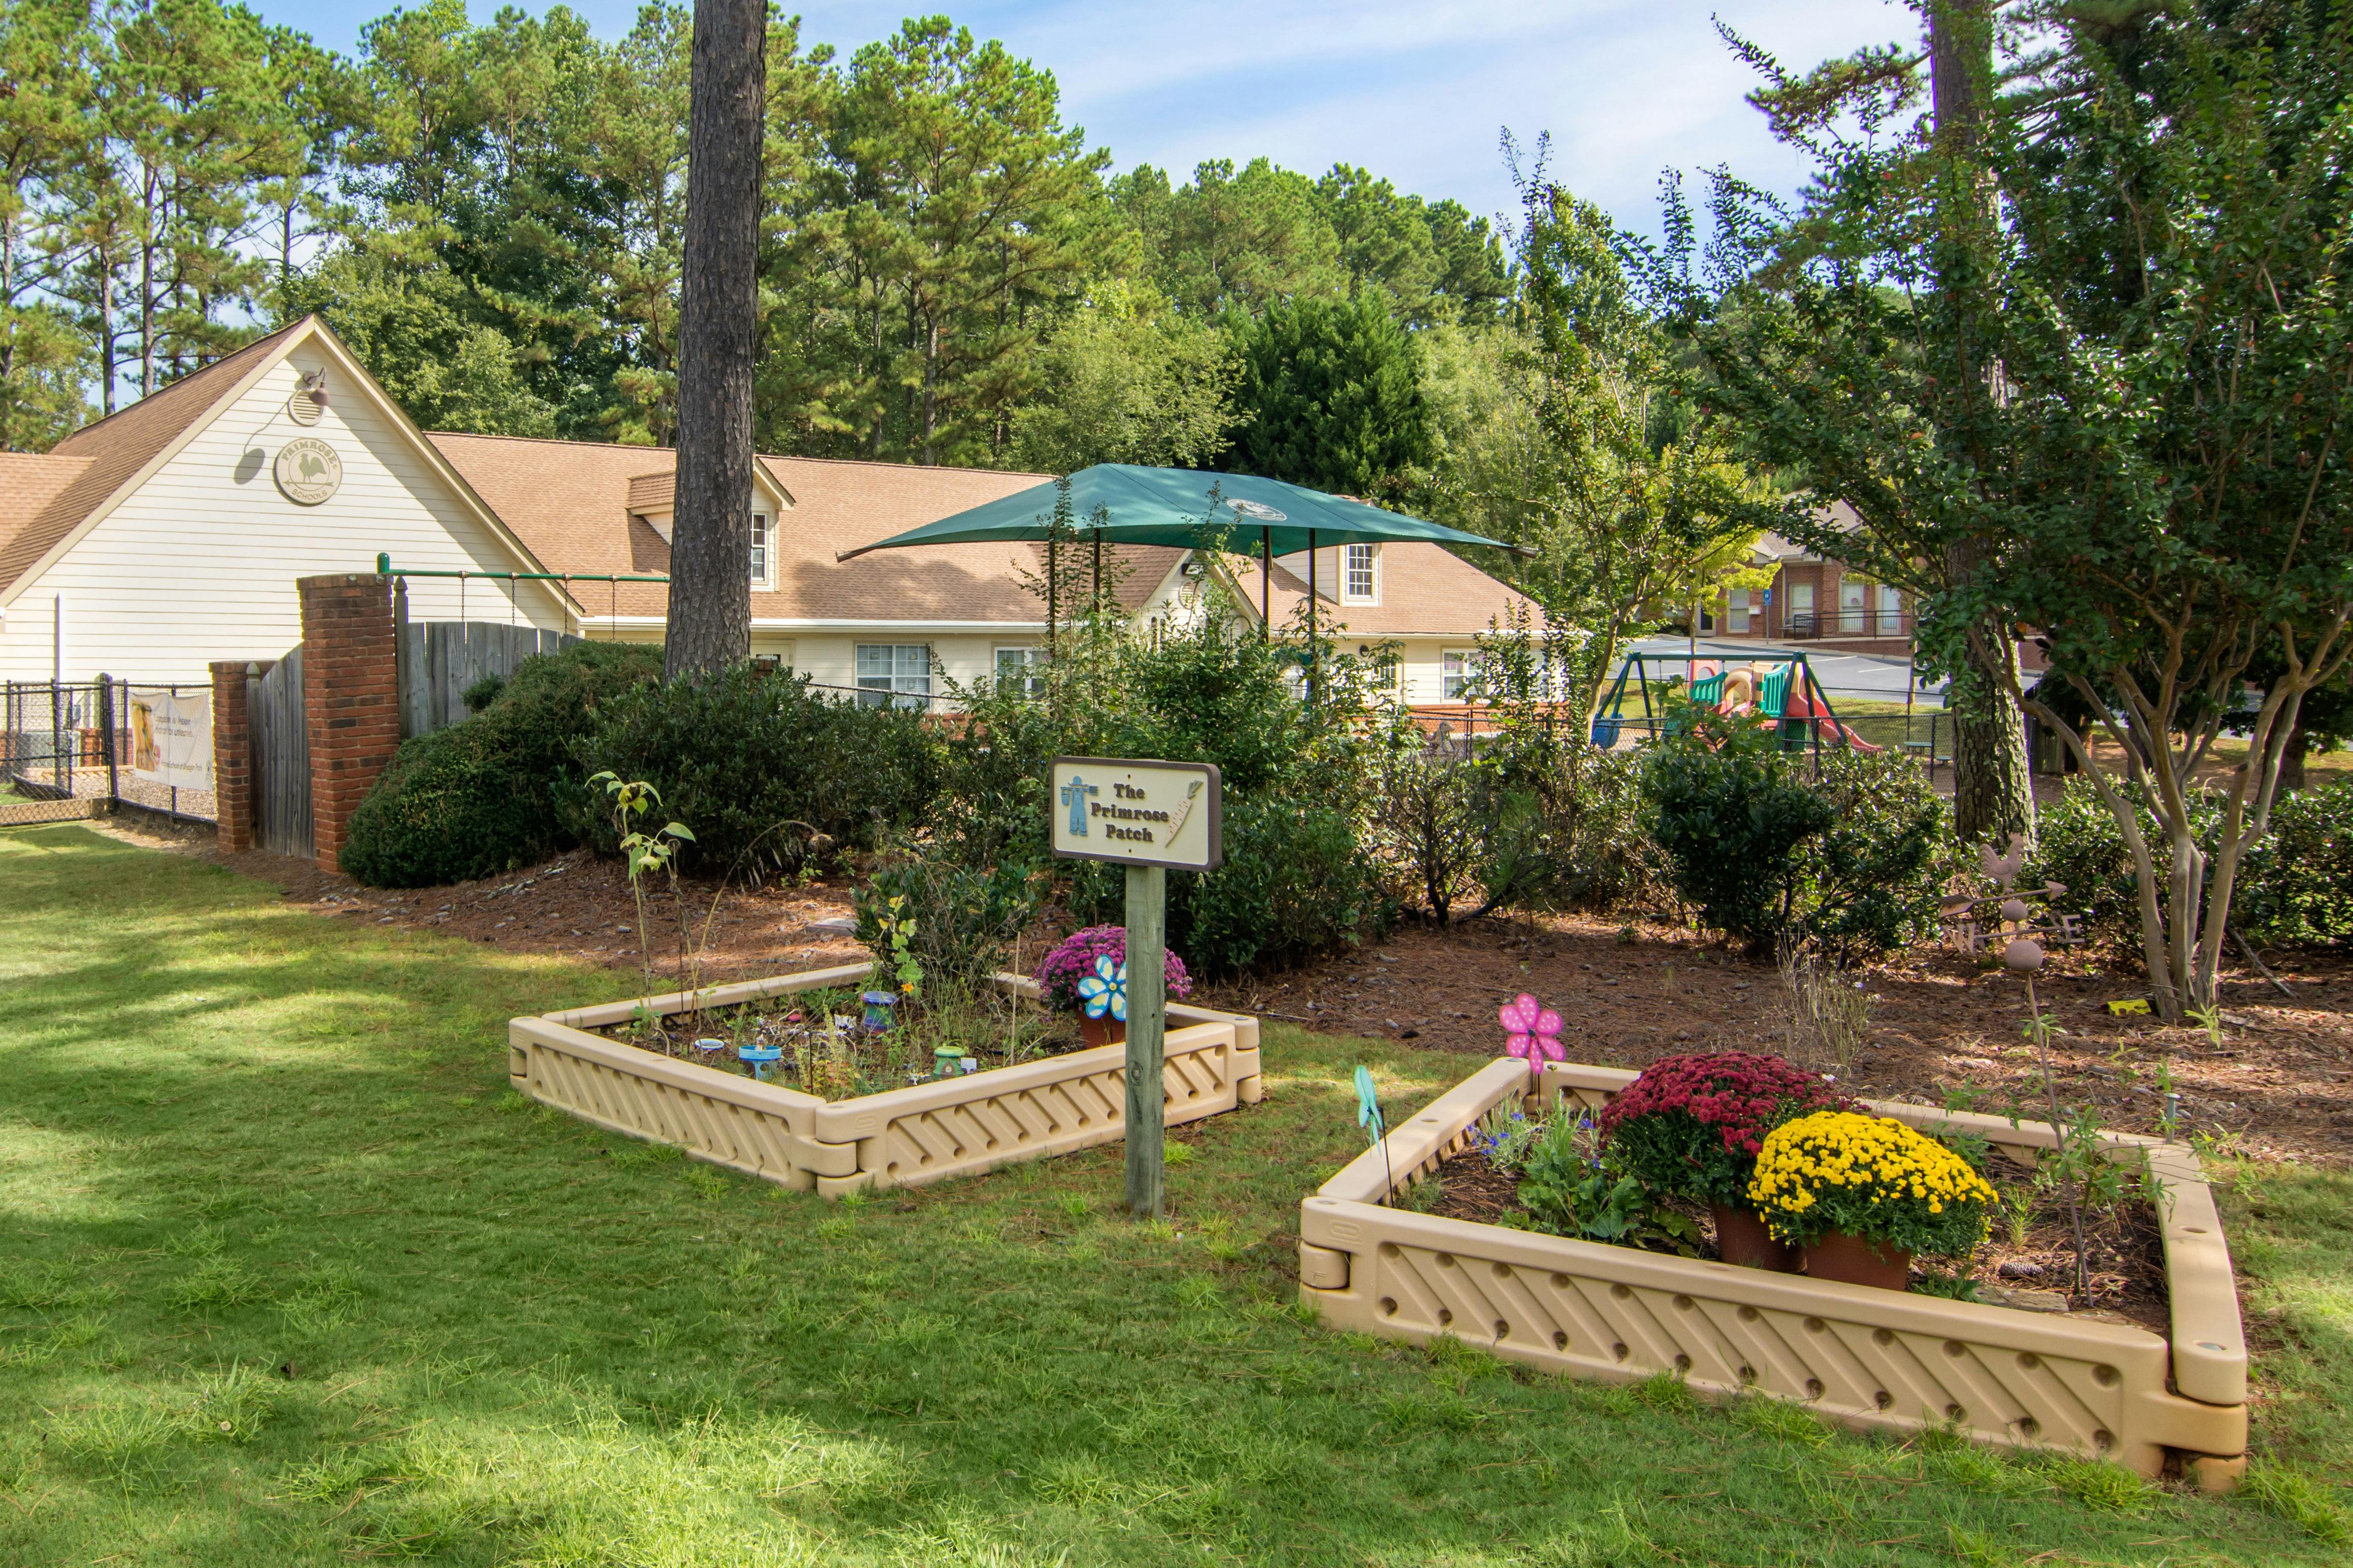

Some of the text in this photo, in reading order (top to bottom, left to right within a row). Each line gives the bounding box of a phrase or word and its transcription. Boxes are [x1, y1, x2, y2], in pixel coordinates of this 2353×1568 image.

[281, 441, 337, 464] PRIMROSE
[292, 489, 327, 500] SCHOOLS
[1113, 783, 1145, 799] The
[1091, 802, 1169, 822] Primrose
[1105, 824, 1153, 842] Patch
[2061, 914, 2085, 942] E
